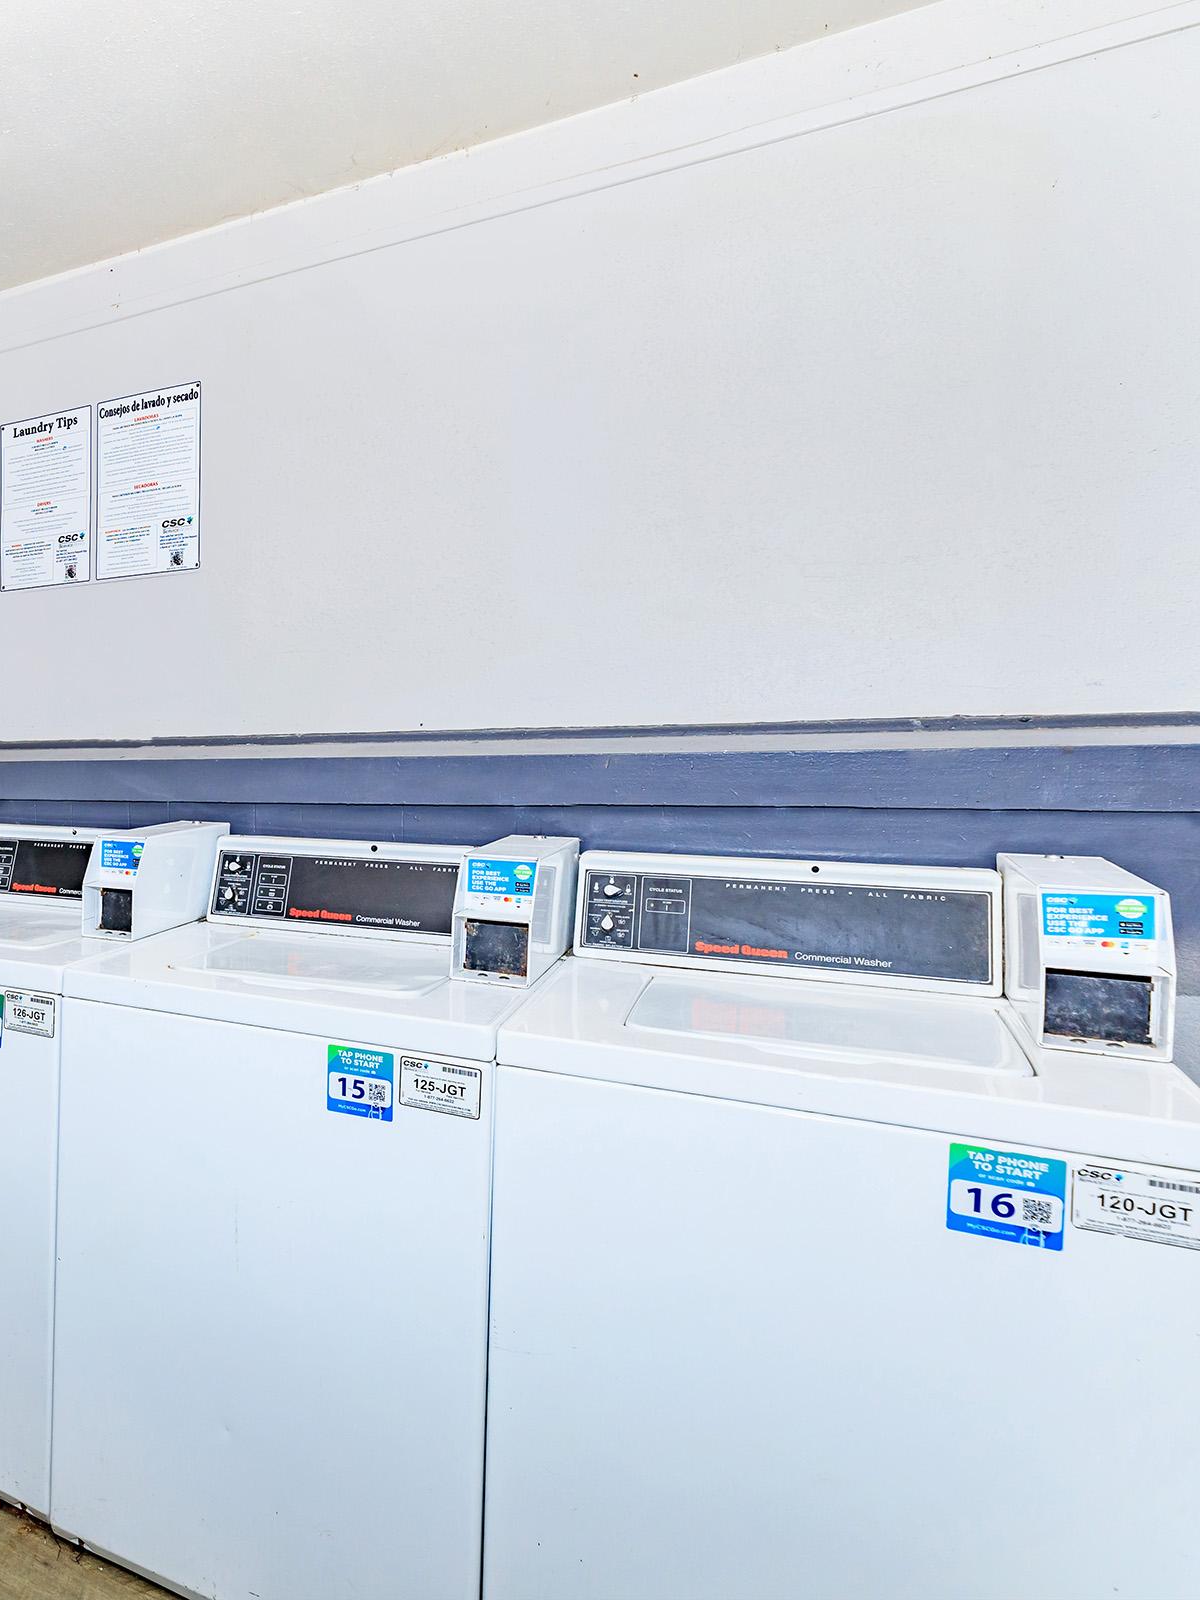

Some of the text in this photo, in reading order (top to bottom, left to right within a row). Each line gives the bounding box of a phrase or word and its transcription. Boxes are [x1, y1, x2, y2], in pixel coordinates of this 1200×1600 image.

[99, 388, 199, 419] Consejos de lavado y secado
[13, 416, 78, 438] Laundry Tips
[161, 518, 186, 528] CSC
[58, 533, 79, 543] CSC
[12, 882, 34, 892] Speed
[34, 884, 57, 893] Queen
[725, 883, 788, 892] PERMANENT
[800, 887, 835, 895] PRESS
[903, 893, 947, 902] FABRIC
[289, 907, 421, 928] Speed Queen Commercial Washer
[1046, 914, 1109, 922] EXPERIENCE
[694, 941, 893, 969] Speed Queen Commercial Washer
[6, 993, 19, 1001] CSC
[13, 1007, 46, 1021] 126-JGT
[337, 1049, 384, 1063] TAP PHONE
[341, 1057, 380, 1069] TO START
[403, 1060, 423, 1069] CSC
[337, 1077, 366, 1099] 15
[413, 1078, 467, 1098] 125-JGT
[967, 1150, 1050, 1173] TAP PHONE
[972, 1160, 1043, 1180] TO START
[1077, 1168, 1112, 1180] CSC
[967, 1187, 1016, 1219] 16
[1096, 1193, 1194, 1222] 120-JGT
